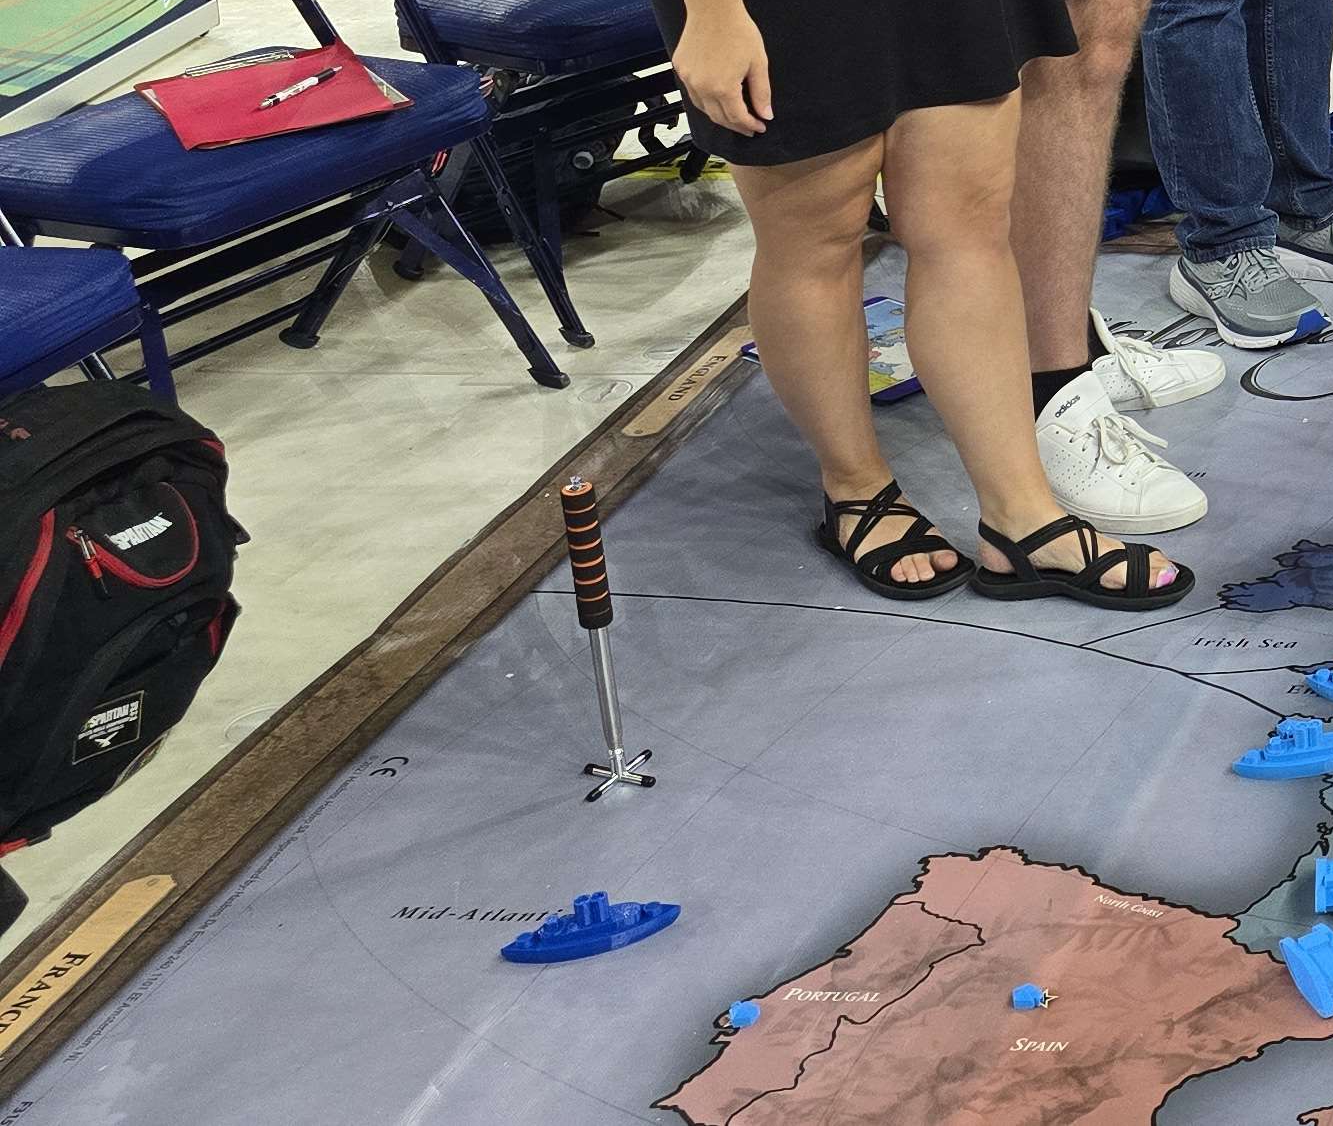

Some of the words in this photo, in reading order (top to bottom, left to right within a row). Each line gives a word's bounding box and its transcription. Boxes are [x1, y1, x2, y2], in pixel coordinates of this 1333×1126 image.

[667, 354, 729, 404] ENGLAND
[1054, 393, 1083, 420] adidas
[110, 514, 173, 551] SPARTAN
[1193, 636, 1253, 651] Irish
[1259, 636, 1298, 651] Sea
[390, 905, 563, 923] Mid-Atlant
[1093, 892, 1126, 913] North
[1128, 901, 1165, 920] Coast
[783, 986, 880, 1004] PORTUGAL
[1010, 1037, 1068, 1054] SPAIN
